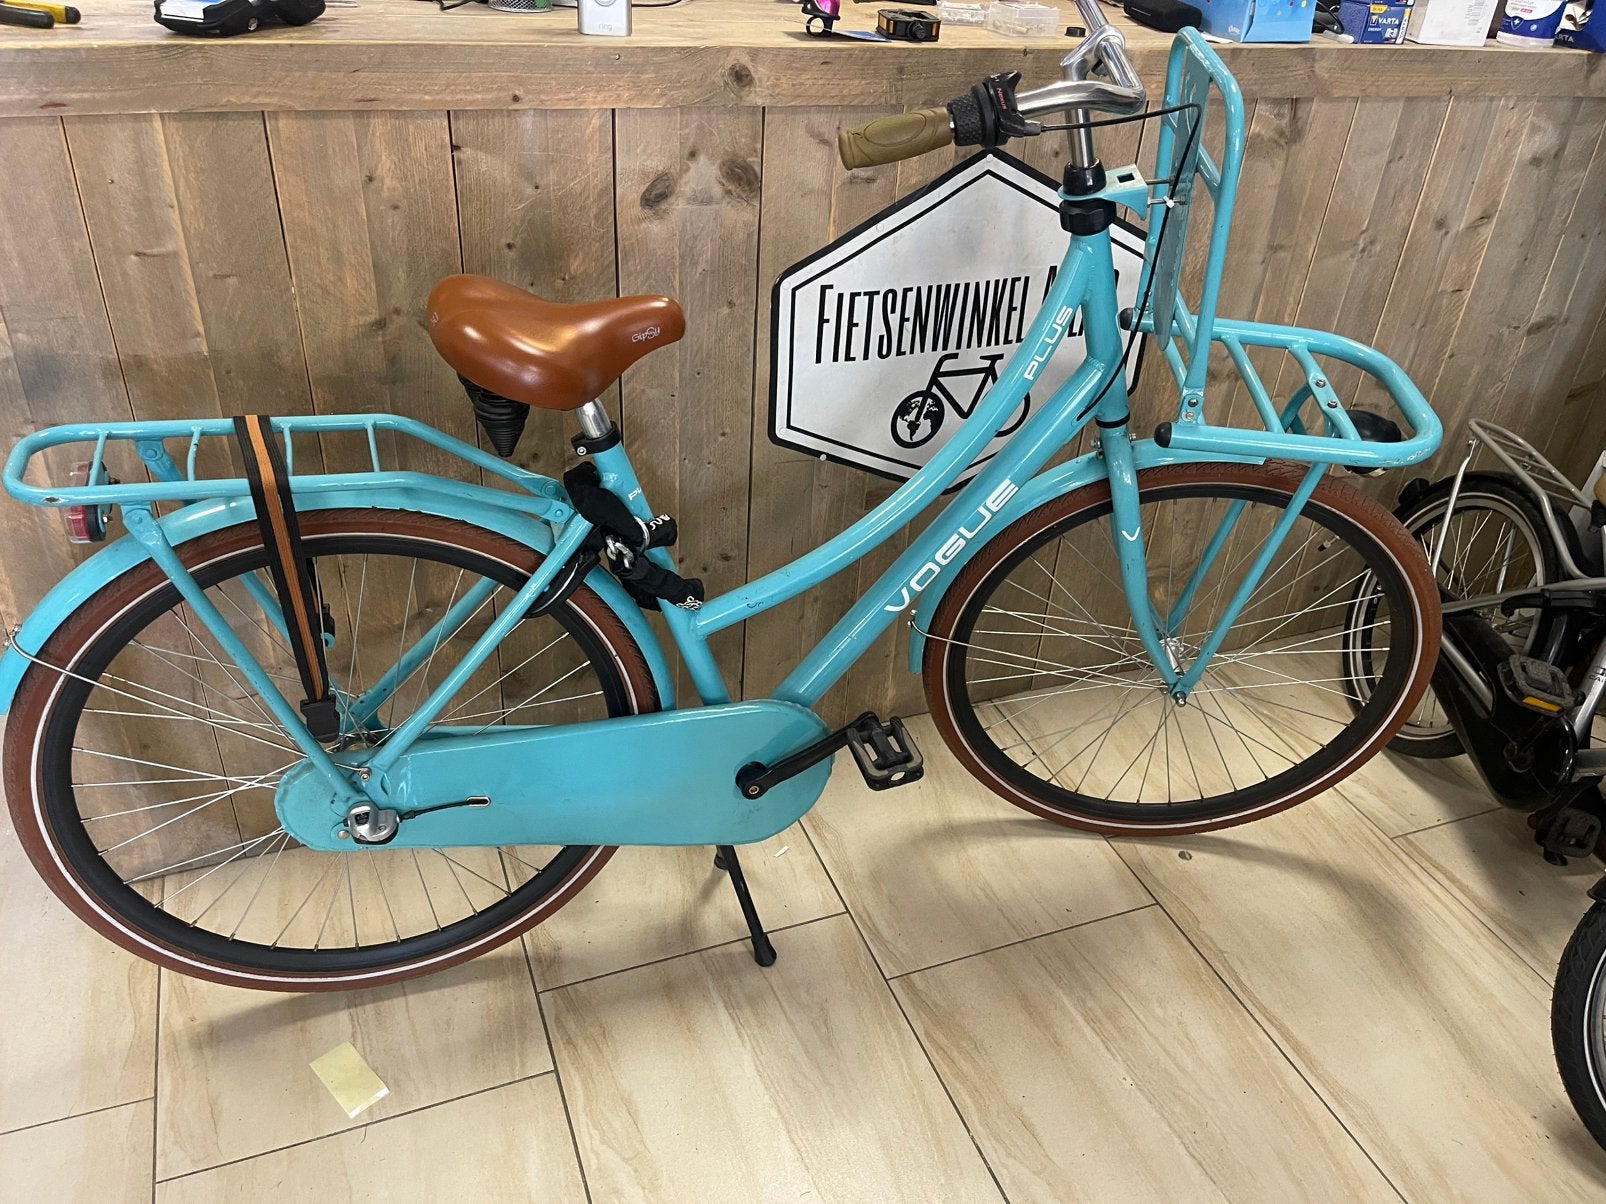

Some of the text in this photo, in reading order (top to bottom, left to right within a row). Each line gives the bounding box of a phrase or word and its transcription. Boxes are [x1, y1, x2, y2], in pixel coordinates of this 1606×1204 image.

[1378, 17, 1399, 25] VARTA
[815, 275, 1031, 364] FIETSENWINKEL
[1023, 305, 1074, 381] PLUS
[883, 478, 1020, 612] VOGUE
